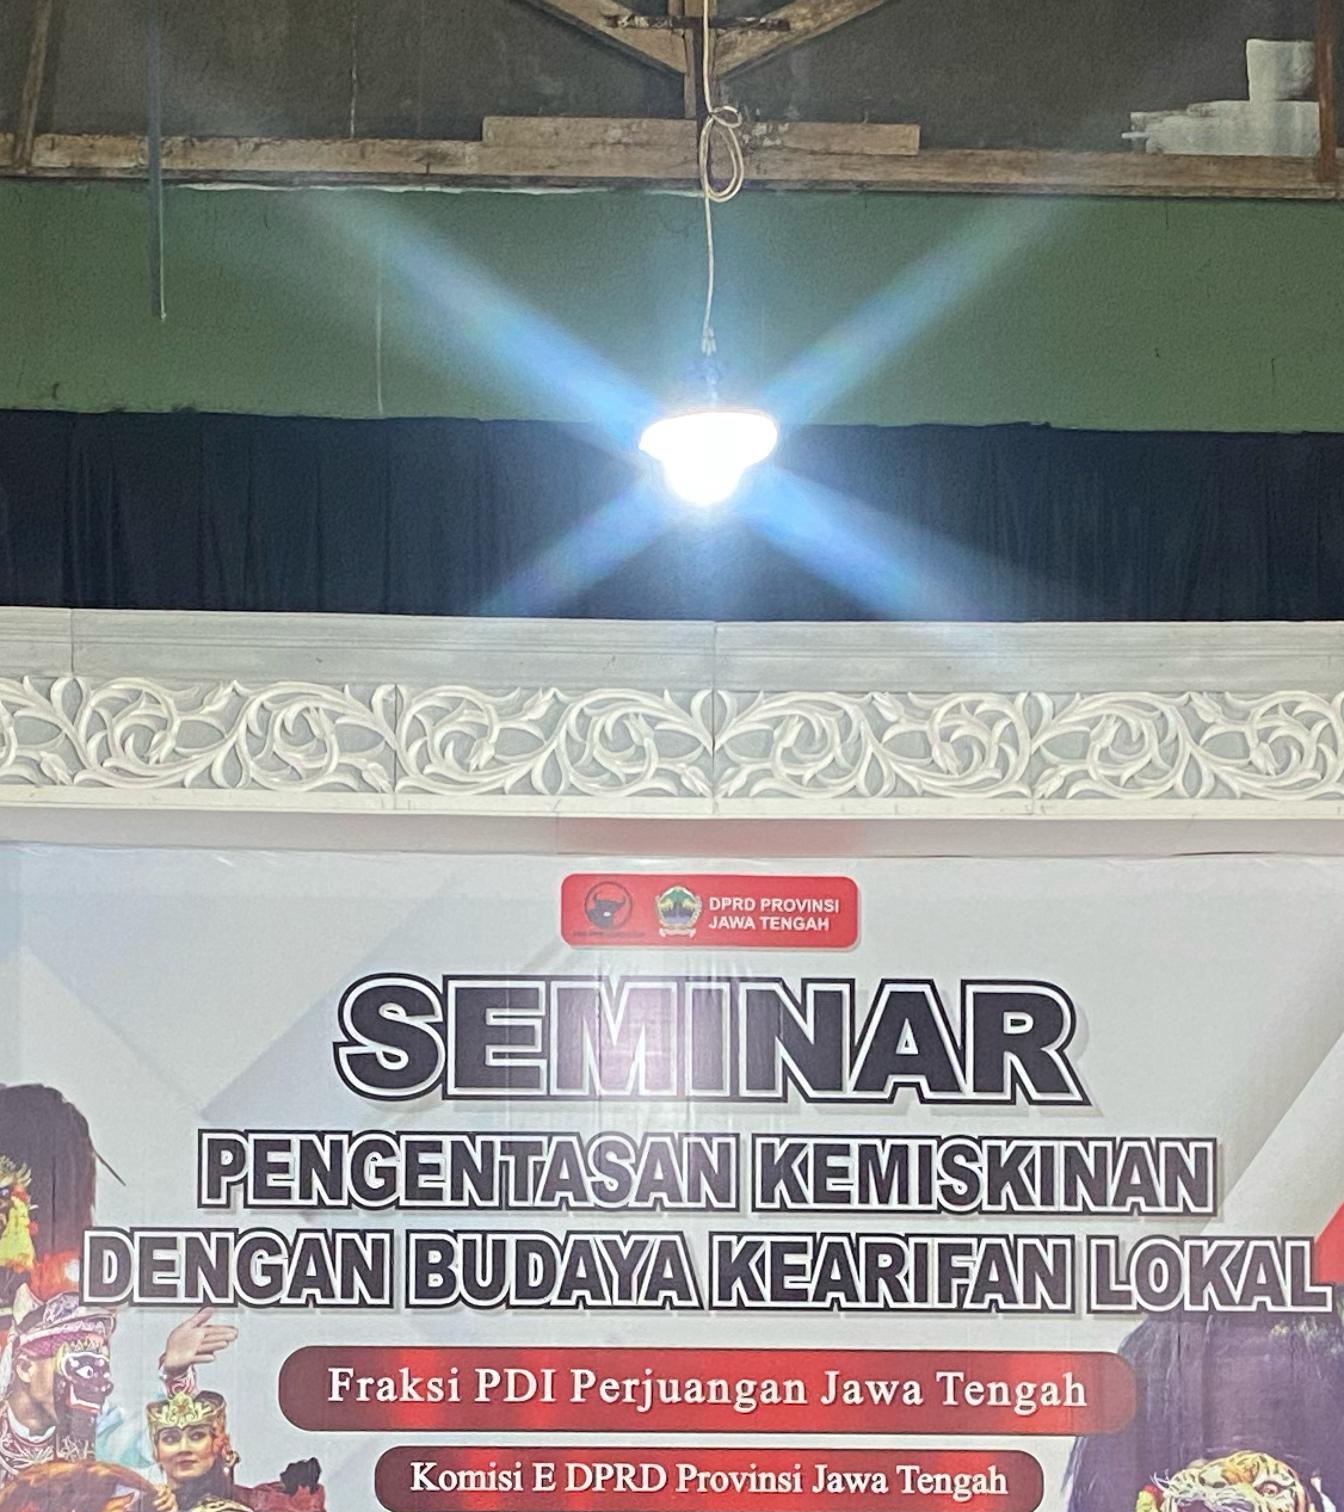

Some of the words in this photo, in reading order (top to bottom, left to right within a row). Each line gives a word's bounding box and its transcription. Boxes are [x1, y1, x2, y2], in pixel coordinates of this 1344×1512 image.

[708, 916, 755, 930] JAWA
[760, 916, 829, 931] TENGAH
[709, 896, 755, 911] DPRD
[760, 896, 839, 913] PROVINSI
[334, 974, 1090, 1106] SEMINAR
[198, 1129, 739, 1211] PENGENTASAN
[752, 1133, 1217, 1216] KEMISKINAN
[81, 1226, 393, 1308] DENGAN
[406, 1229, 705, 1310] BUDAYA
[708, 1231, 1076, 1313] KEARIFAN
[1087, 1235, 1336, 1314] LOKAL
[327, 1367, 460, 1403] Fraksi
[474, 1368, 556, 1403] PDI
[570, 1368, 808, 1414] Perjuangan
[820, 1370, 924, 1406] Jawa
[936, 1371, 1088, 1416] Tengah
[409, 1461, 524, 1492] Komisi
[532, 1463, 556, 1492] E
[565, 1463, 668, 1493] DPRD
[675, 1463, 804, 1494] Provinsi
[811, 1464, 889, 1495] Jawa
[896, 1465, 1009, 1502] Tengah
